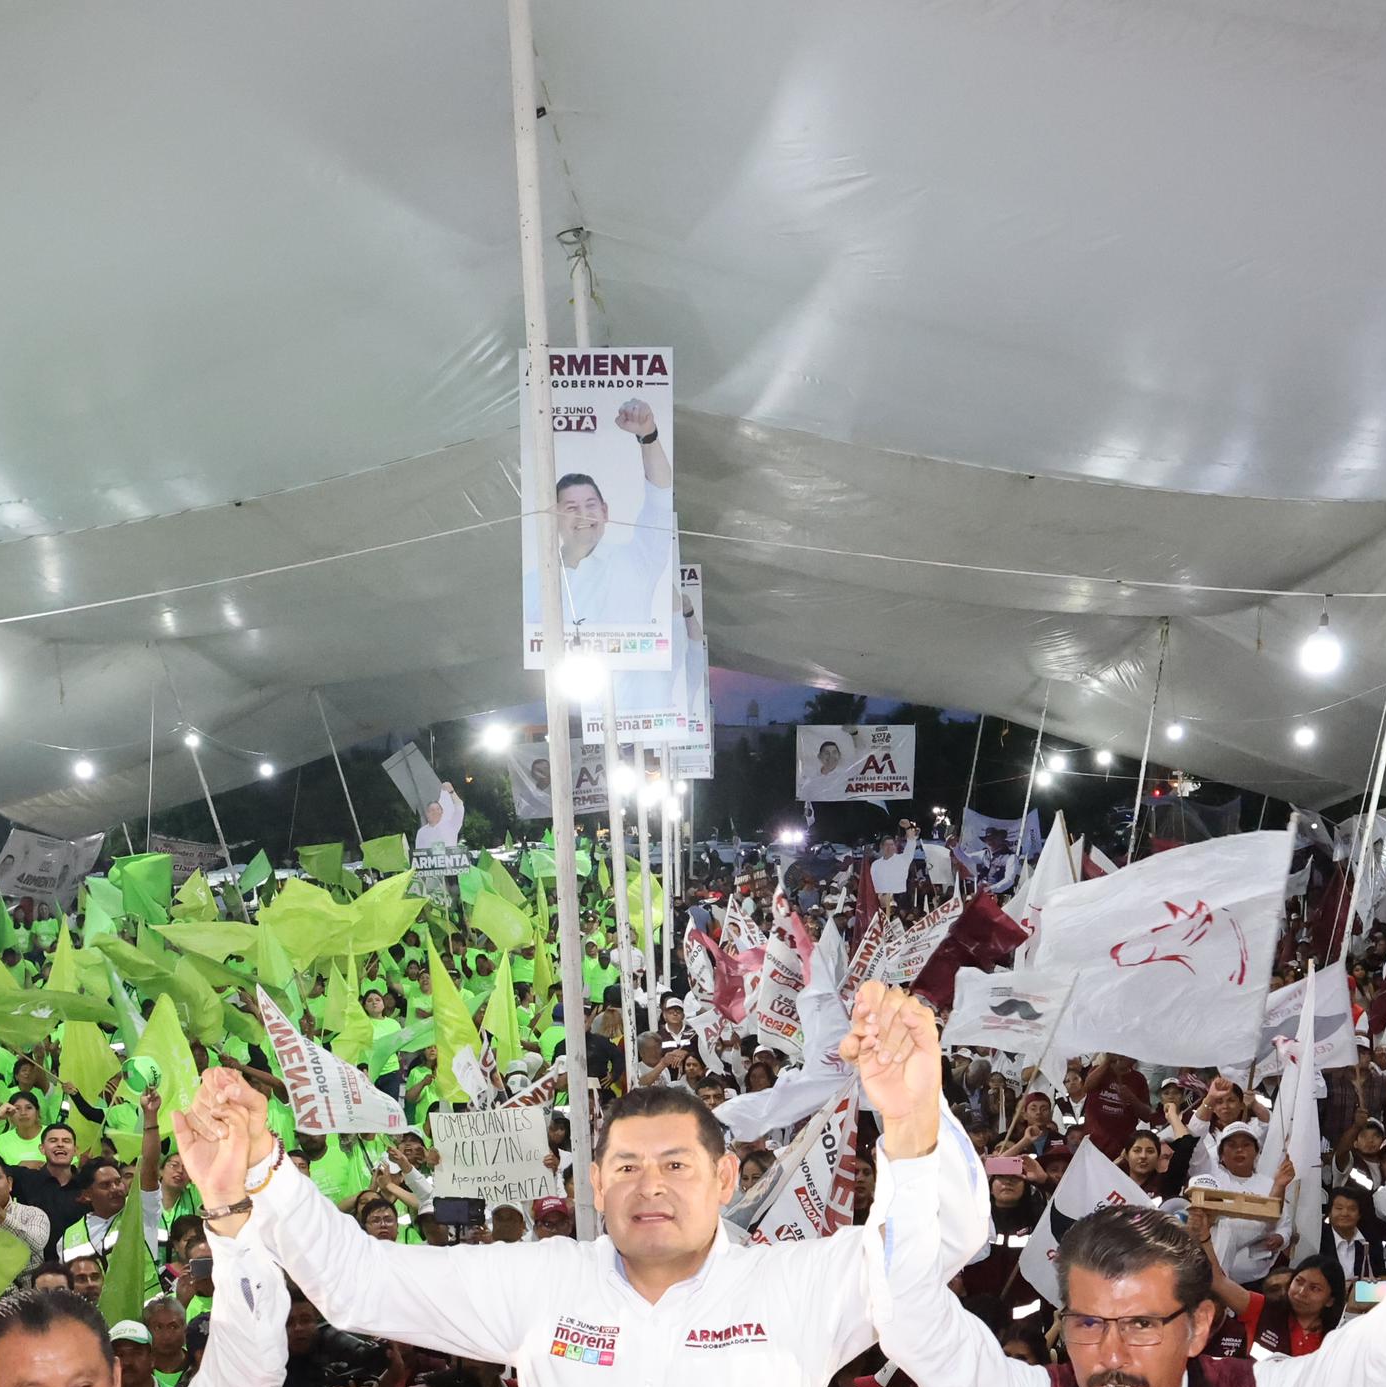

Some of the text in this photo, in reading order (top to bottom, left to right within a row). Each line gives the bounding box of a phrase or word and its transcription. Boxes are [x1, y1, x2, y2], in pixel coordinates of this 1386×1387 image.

[527, 354, 668, 376] RMENTA
[551, 380, 644, 388] GOBERNADOR
[552, 416, 596, 431] OTA
[530, 639, 603, 653] mrena
[587, 719, 641, 732] moena
[845, 782, 910, 793] ARMENTA
[412, 853, 470, 869] ARMENTA
[436, 1108, 533, 1143] COMERCIANTES
[453, 1136, 523, 1168] ACATZIN
[451, 1171, 506, 1189] Apoyando
[477, 1175, 551, 1202] ARMENTA
[797, 1190, 821, 1226] AMOR
[554, 1326, 616, 1350] morena
[686, 1323, 766, 1342] ARMENTA
[702, 1338, 750, 1349] GOBERNADOR
